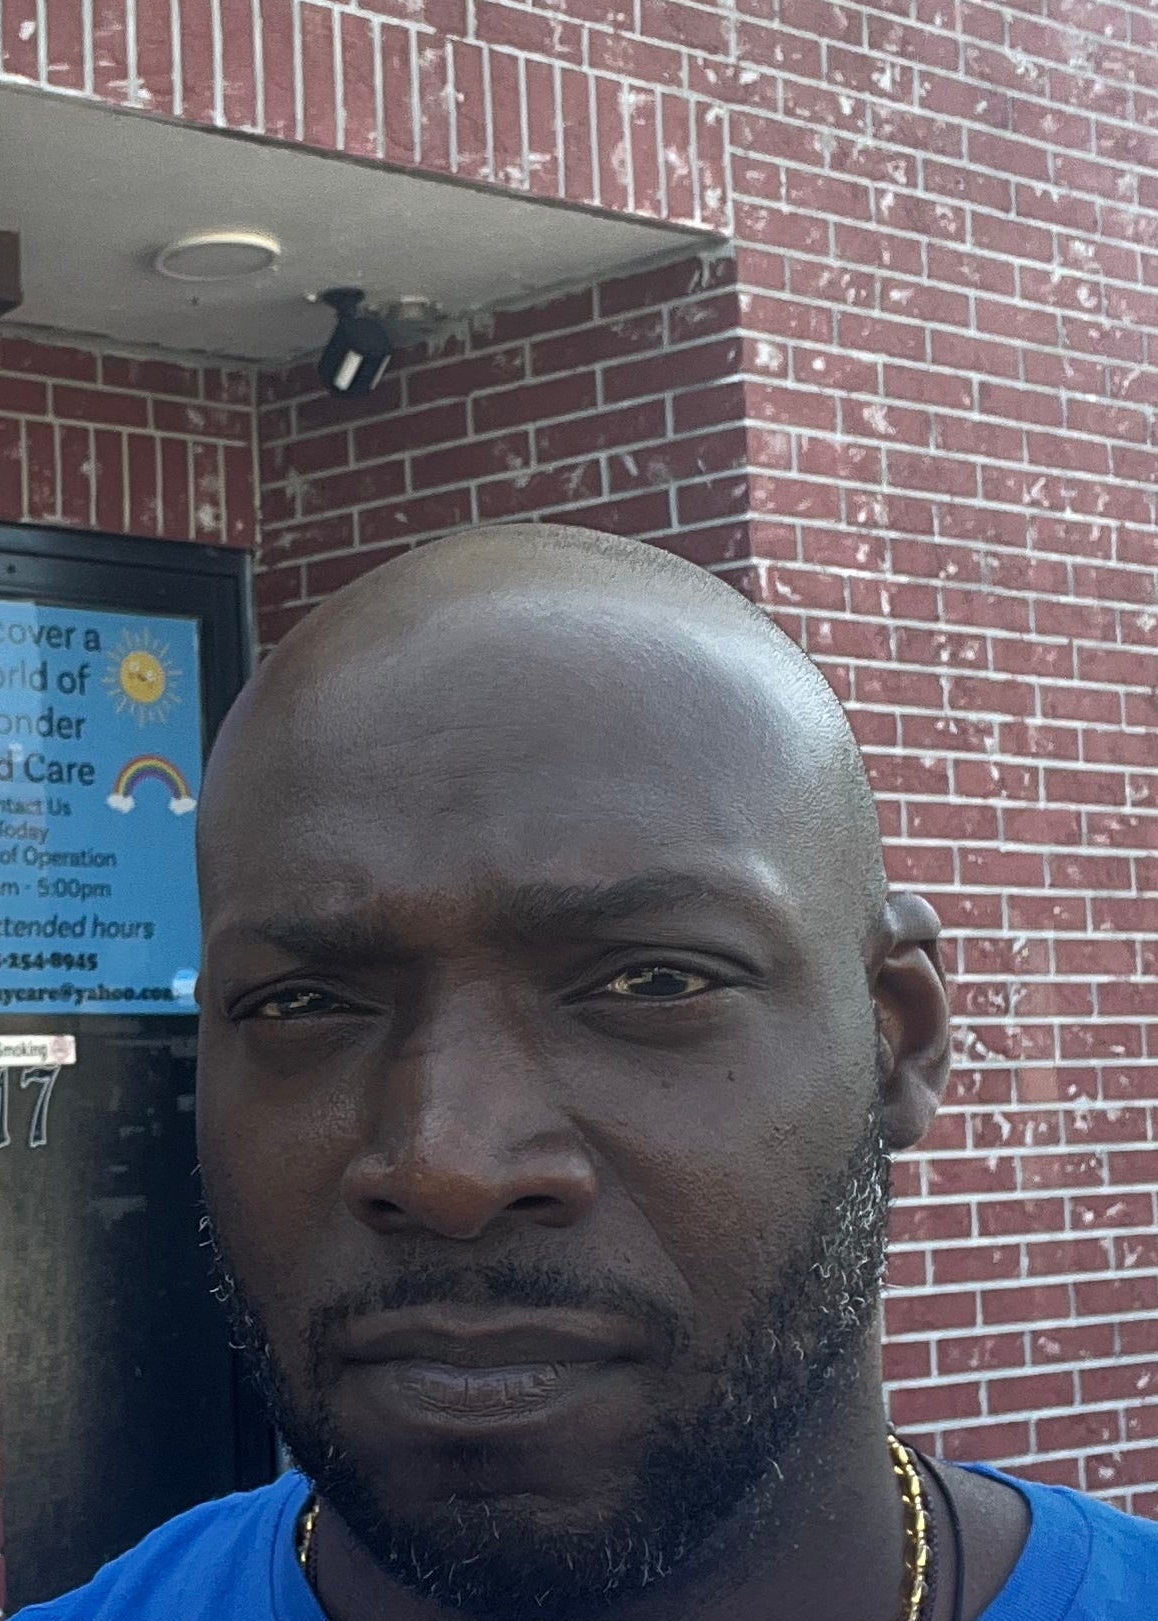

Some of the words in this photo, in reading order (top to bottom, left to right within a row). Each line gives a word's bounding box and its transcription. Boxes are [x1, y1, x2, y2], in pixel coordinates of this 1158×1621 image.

[84, 628, 102, 653] a
[57, 661, 91, 695] of
[23, 752, 96, 787] Care
[46, 797, 72, 817] Us
[0, 844, 19, 866] of
[23, 844, 117, 871] Operation
[37, 876, 112, 902] 5:00pm
[90, 912, 156, 941] hours
